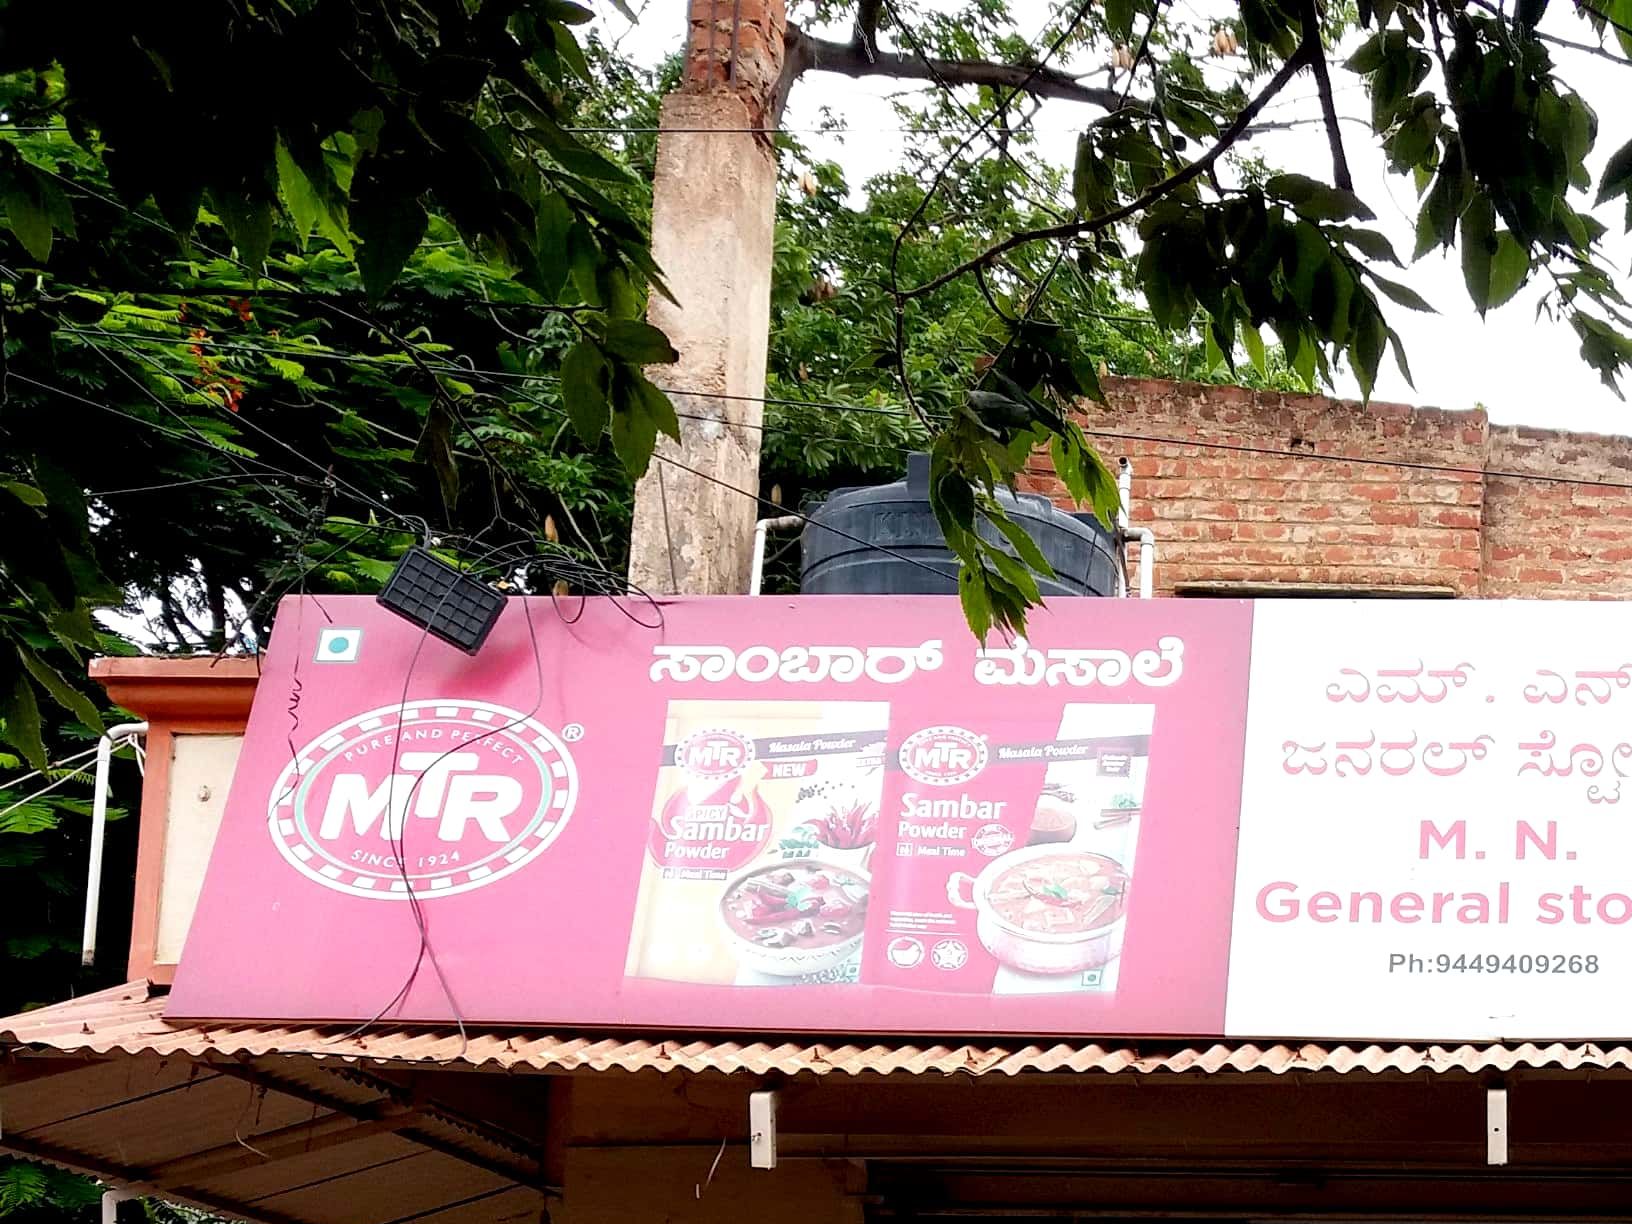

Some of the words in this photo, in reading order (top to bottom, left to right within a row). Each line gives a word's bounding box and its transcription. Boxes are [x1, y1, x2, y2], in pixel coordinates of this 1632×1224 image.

[648, 639, 943, 684] ಸಾಂಬಾರ್
[344, 734, 394, 762] PURE
[401, 728, 443, 741] AND
[689, 740, 741, 767] MTR
[914, 741, 972, 770] MTR
[1281, 729, 1495, 777] ಜನರಲ್
[772, 763, 807, 778] NEW
[319, 751, 523, 842] MTR
[900, 792, 1008, 820] Sambar
[670, 815, 769, 843] Sambar
[897, 821, 968, 840] Powder
[1419, 820, 1486, 860] M.
[1515, 820, 1577, 860] N.
[351, 849, 407, 869] SINC
[418, 850, 460, 868] 1924
[664, 840, 730, 860] Powder
[1255, 881, 1510, 924] General
[1388, 953, 1600, 975] Ph:9449409268
